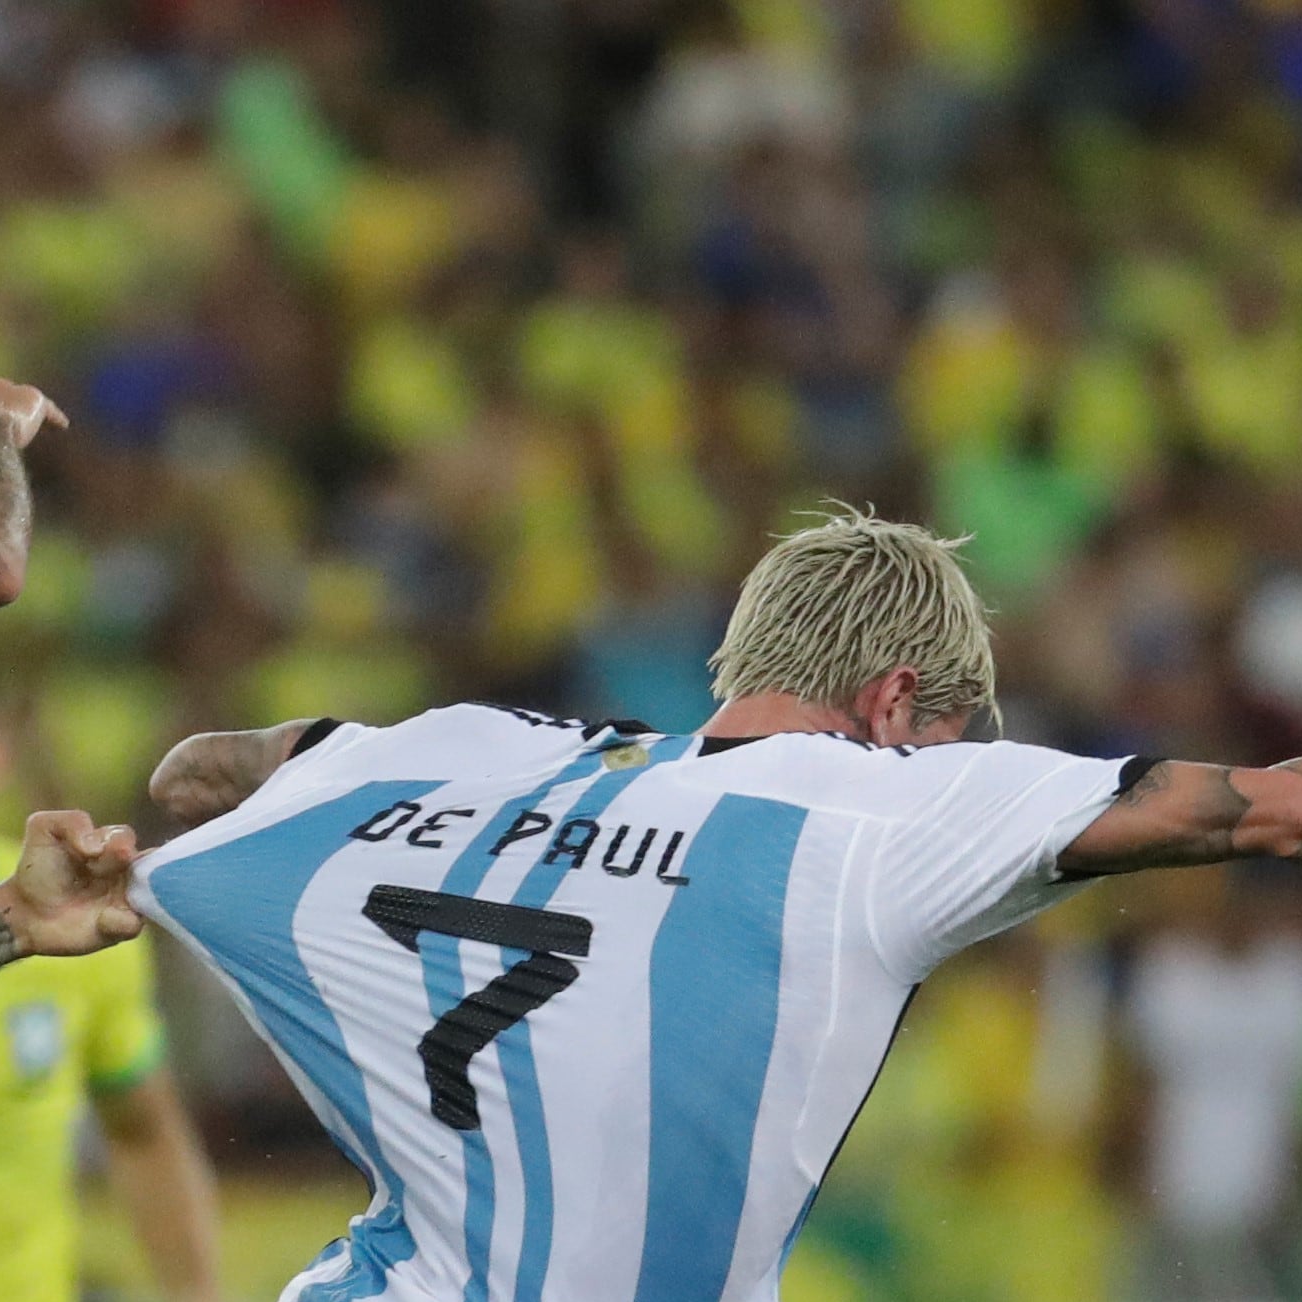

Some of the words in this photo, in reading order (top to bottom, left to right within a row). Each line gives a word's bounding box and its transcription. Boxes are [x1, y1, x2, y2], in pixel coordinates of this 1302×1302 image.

[347, 800, 476, 849] DE
[488, 809, 690, 887] PAUL
[361, 883, 594, 1132] 7
